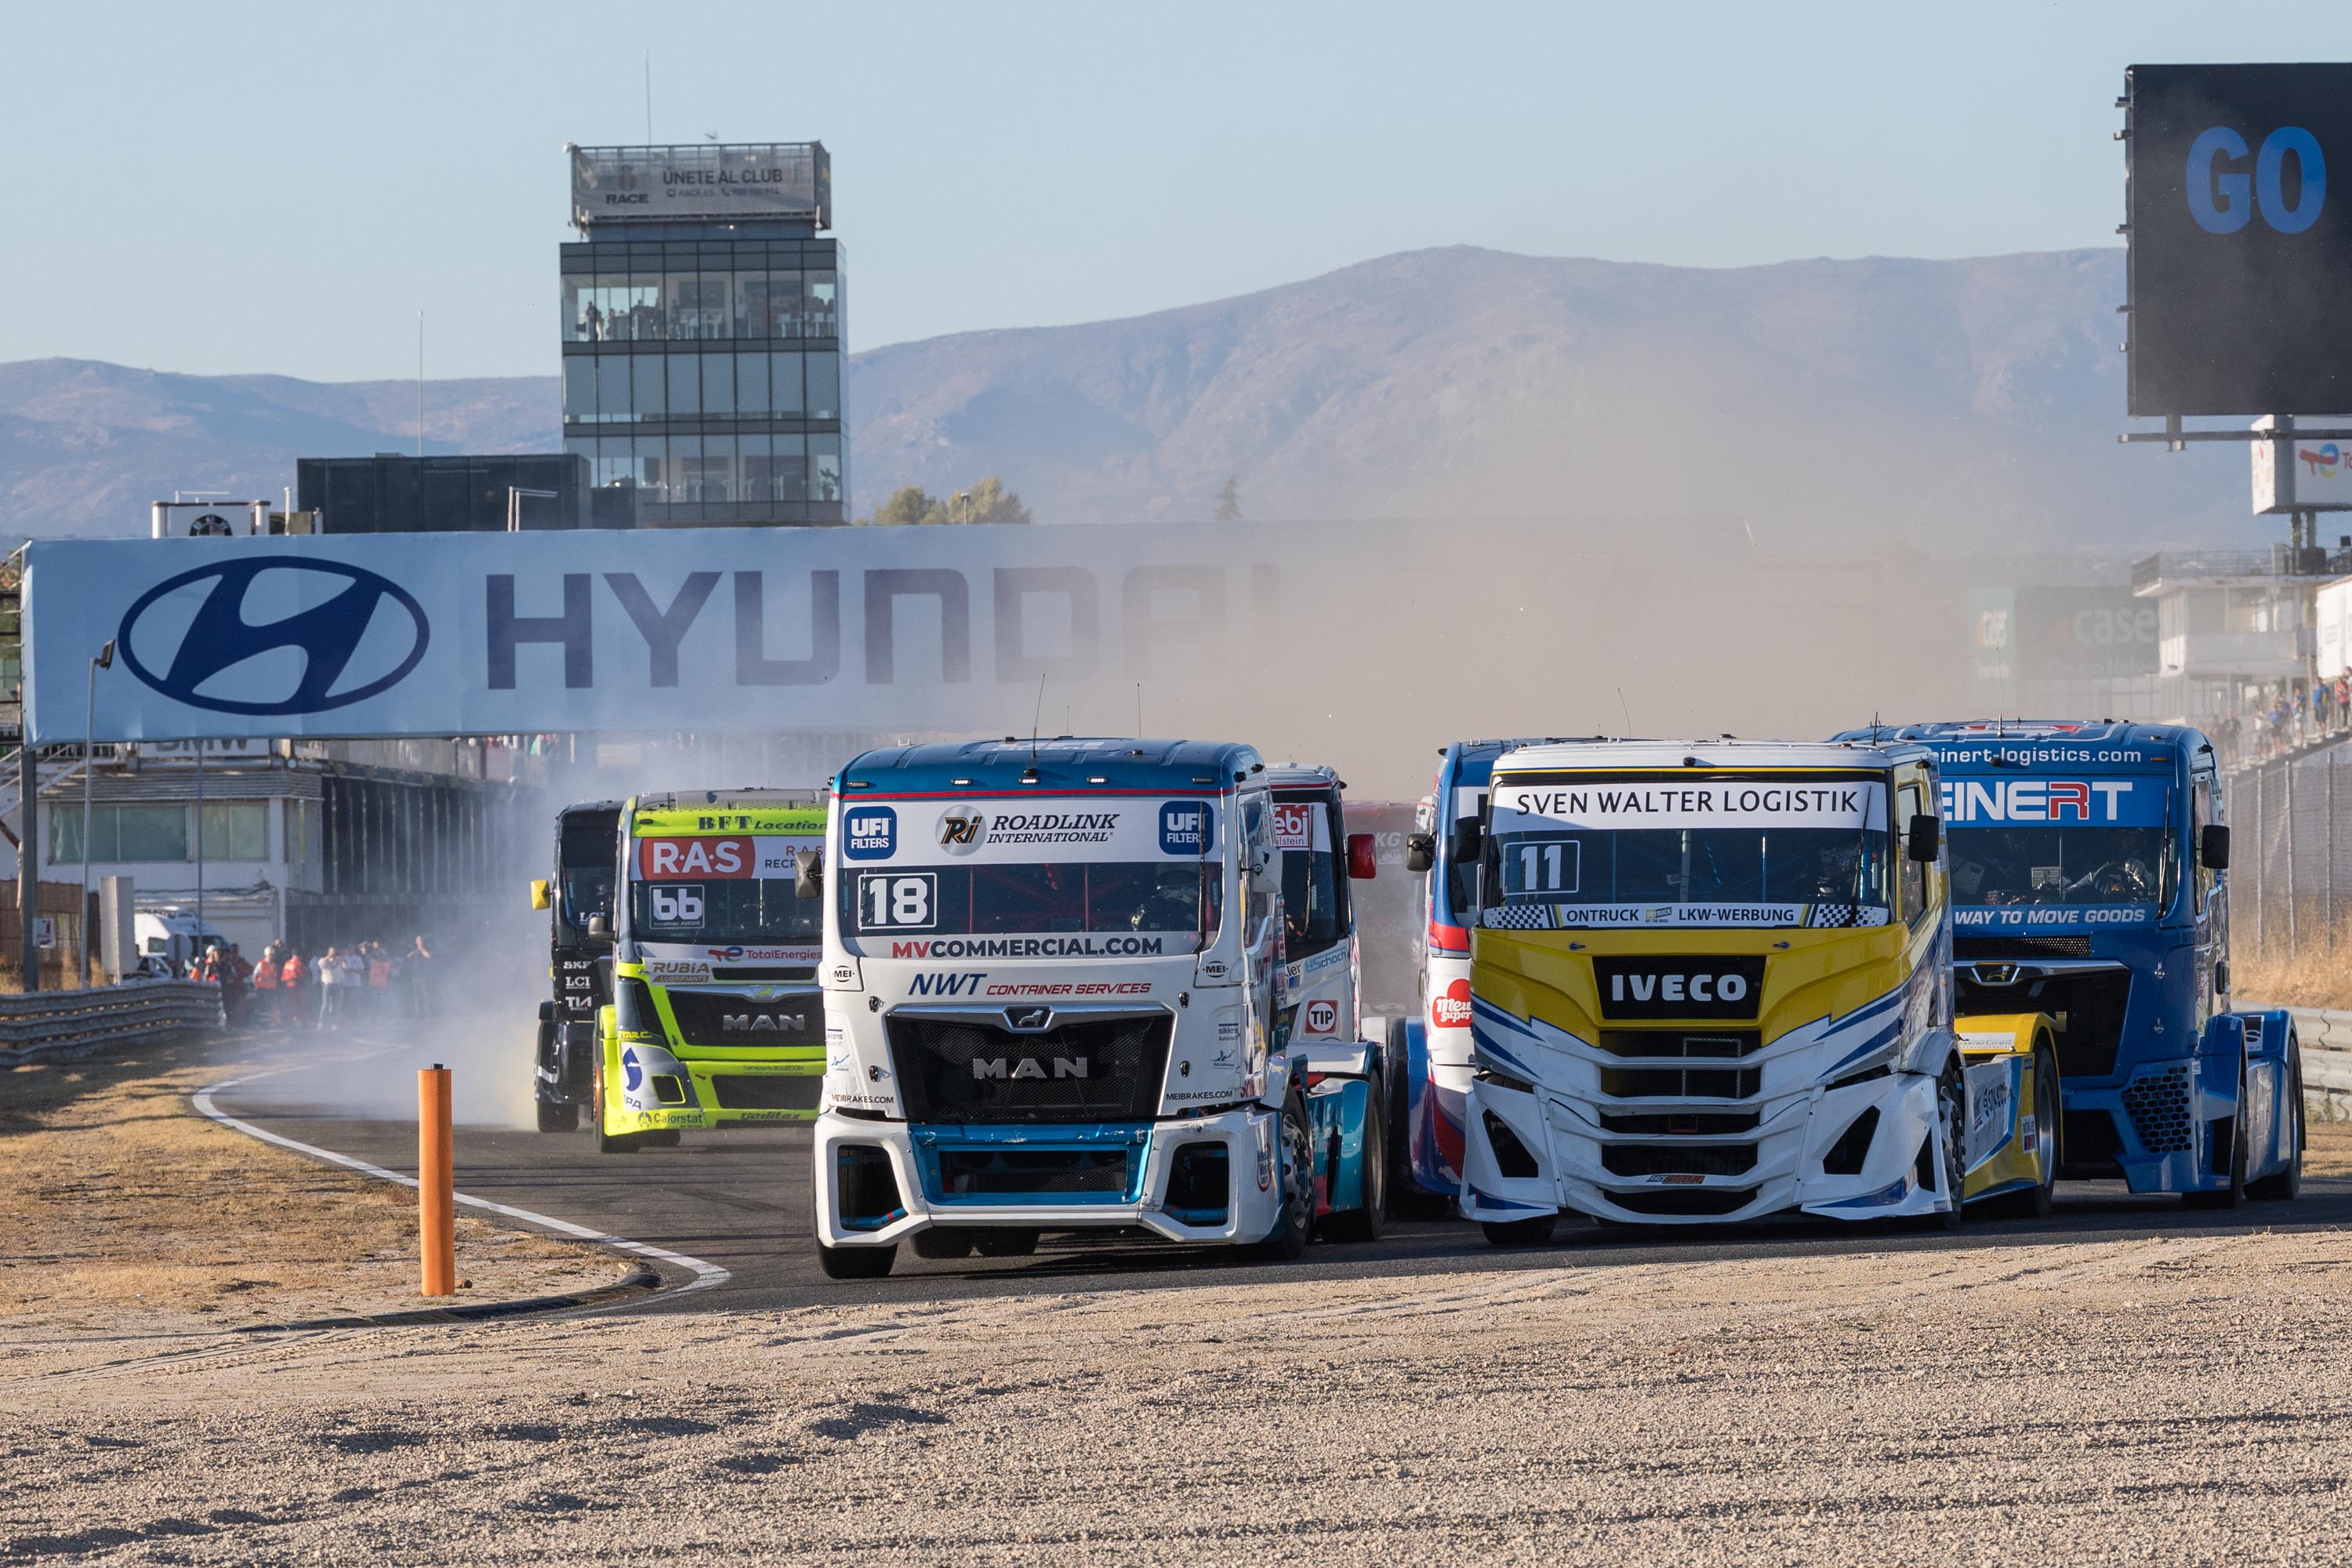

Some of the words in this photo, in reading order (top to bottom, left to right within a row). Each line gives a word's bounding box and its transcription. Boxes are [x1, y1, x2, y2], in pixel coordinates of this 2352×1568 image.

[718, 169, 739, 184] AL
[742, 168, 783, 183] CLUB
[2186, 125, 2327, 234] GO
[605, 194, 649, 205] RACE
[2075, 606, 2158, 644] case
[1516, 793, 1588, 815] SVEN
[1598, 790, 1715, 813] WALTER
[1724, 789, 1859, 812] LOGISTIK
[698, 815, 753, 831] BFT
[851, 817, 889, 837] UFI
[990, 814, 1121, 831] ROADLINK
[1167, 812, 1206, 831] UFI
[851, 837, 890, 849] FILTERS
[986, 832, 1109, 844] INTERNATIONAL
[1276, 836, 1305, 846] ilstein
[1520, 844, 1562, 891] 11
[869, 877, 928, 925] 18
[1566, 909, 1639, 922] ONTRUCK
[1679, 908, 1795, 921] LKW-WERBUNG
[1955, 911, 1995, 924] WAY
[2000, 910, 2024, 924] TO
[2027, 909, 2080, 924] MOVE
[2084, 909, 2146, 923] GOODS
[746, 949, 822, 962] TotalEnergies
[891, 937, 1163, 959] MVCOMMERCIAL.COM
[563, 960, 592, 969] SKF
[565, 977, 590, 986] LCI
[908, 973, 988, 996] NWT
[986, 984, 1073, 996] CONTAINER
[1075, 982, 1152, 995] SERVICES
[1612, 974, 1748, 1002] IVECO
[723, 1014, 805, 1030] MAN
[1310, 1010, 1334, 1025] TIP
[973, 1057, 1088, 1079] MAN
[831, 1094, 895, 1104] MEIBRAKES.COM
[1166, 1090, 1233, 1101] MEIBRAKES.COM
[654, 1112, 703, 1123] Calorstat
